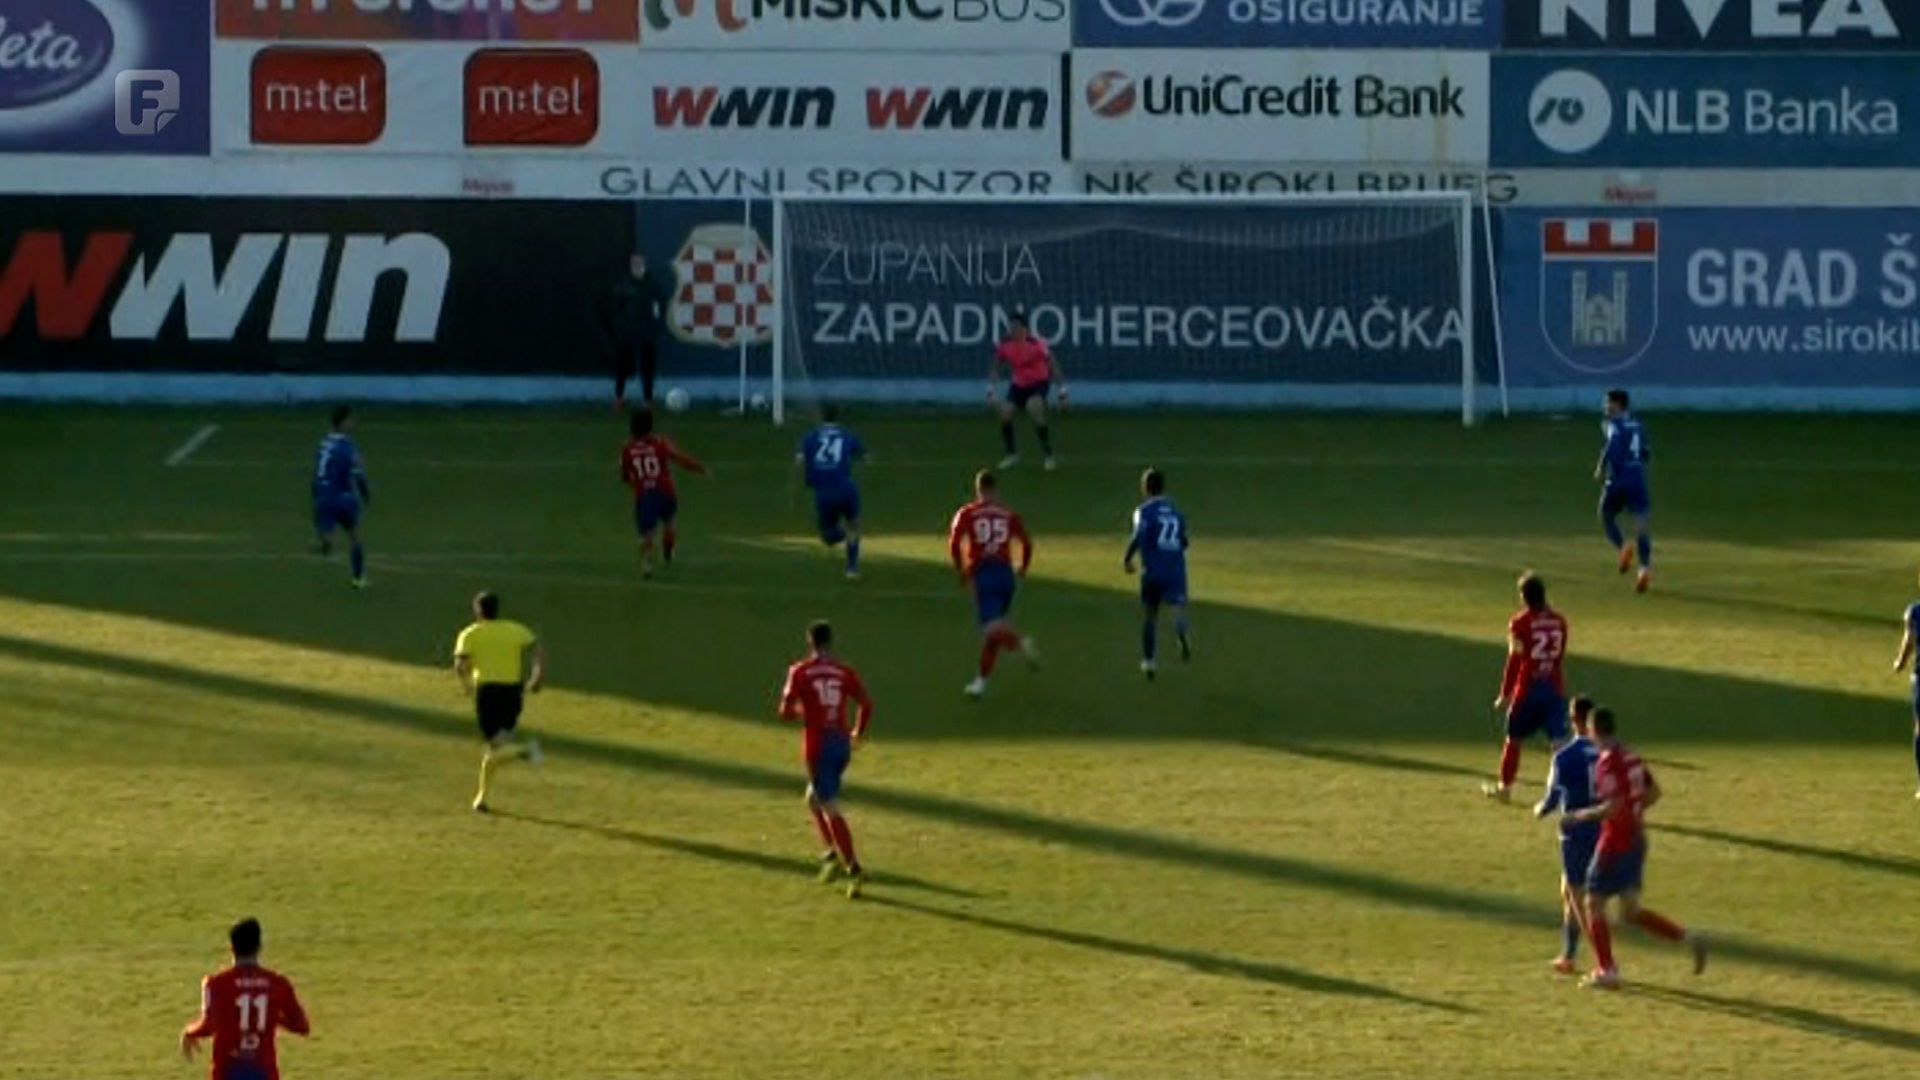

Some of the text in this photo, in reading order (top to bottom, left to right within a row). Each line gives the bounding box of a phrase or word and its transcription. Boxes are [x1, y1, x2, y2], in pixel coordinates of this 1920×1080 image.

[1228, 0, 1484, 25] OSIGURANJE
[1539, 0, 1901, 40] NIVEA
[264, 76, 370, 113] m:tel
[477, 77, 583, 115] m:tel
[1143, 74, 1466, 118] UniCredit Bank
[1625, 87, 1899, 136] NLB Banka
[600, 166, 786, 196] GLAVNI
[807, 168, 1053, 195] SPONZOR
[1085, 169, 1153, 195] NK
[1687, 248, 1858, 309] GRAD
[815, 435, 844, 463] 24
[632, 456, 661, 479] 10
[973, 518, 1009, 544] 95
[1157, 514, 1181, 545] 22
[1530, 630, 1562, 660] 23
[235, 993, 269, 1032] 11
